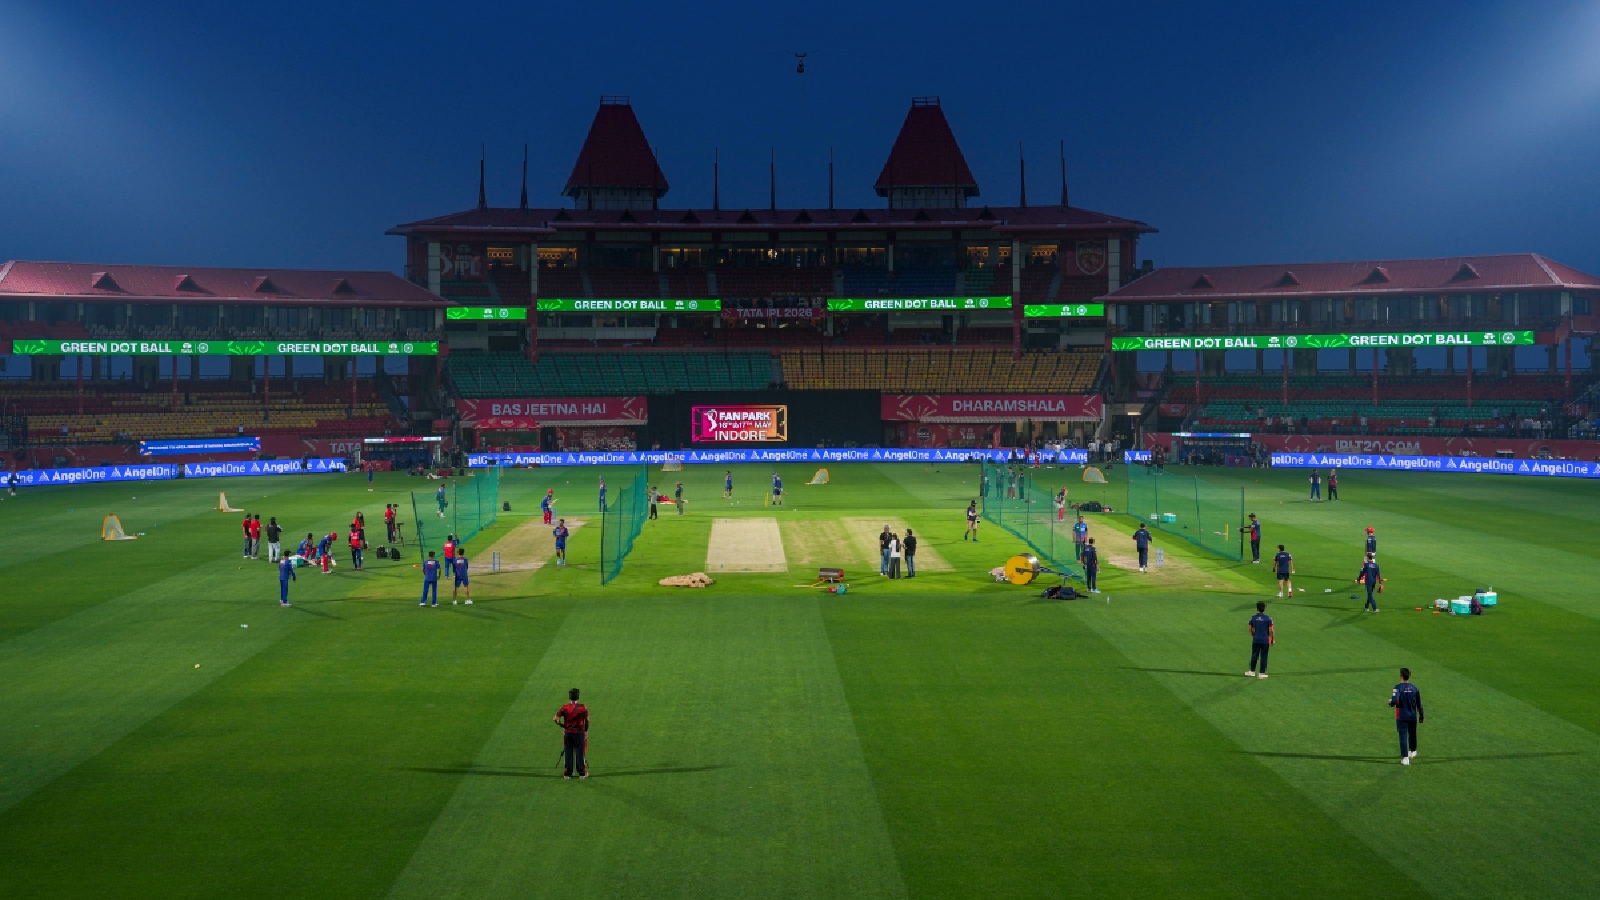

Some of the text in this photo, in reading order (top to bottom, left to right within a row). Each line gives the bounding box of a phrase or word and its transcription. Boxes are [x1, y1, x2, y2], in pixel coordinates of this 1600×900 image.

[455, 261, 480, 275] IPL
[574, 300, 612, 309] GREEN
[615, 300, 637, 309] DOT
[640, 300, 667, 309] BALL
[864, 300, 902, 309] GREEN
[904, 299, 928, 309] DOT
[930, 299, 957, 308] BALL
[737, 308, 812, 317] TATA IPL 2026
[1145, 338, 1192, 349] GREEN
[1194, 337, 1221, 348] DOT
[1224, 337, 1257, 348] BALL
[1349, 335, 1399, 345] GREEN
[1402, 334, 1432, 345] DOT
[1435, 334, 1472, 344] BALL
[61, 343, 172, 353] GREEN DOT BALL
[278, 343, 380, 353] GREEN DOT BALL
[491, 403, 607, 416] BAS JEETNA HAI
[952, 400, 1066, 412] DHARAMSHALA
[720, 412, 770, 420] FAN PARK
[715, 431, 767, 440] INDORE
[329, 443, 362, 453] TATA
[195, 463, 246, 476] AngelOne
[1459, 458, 1513, 471] AngelOne
[1532, 461, 1588, 475] AngelOne
[52, 469, 106, 483] AngelOne
